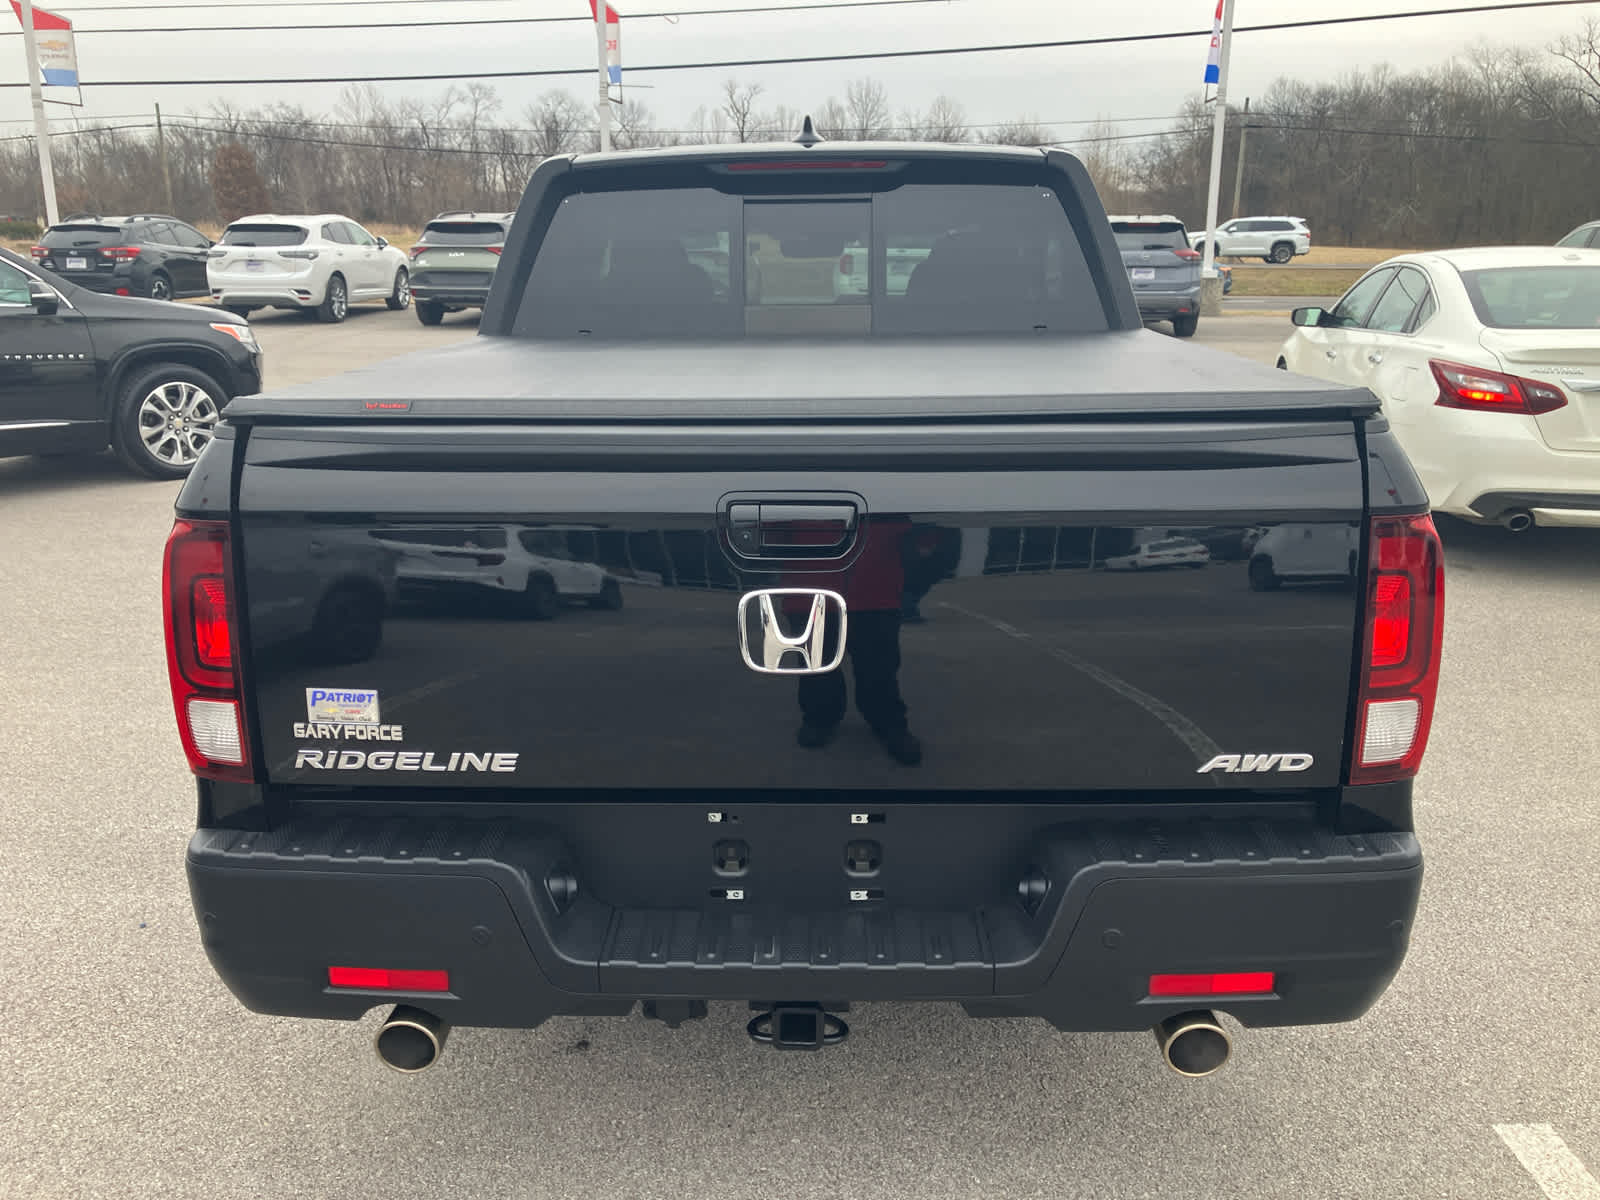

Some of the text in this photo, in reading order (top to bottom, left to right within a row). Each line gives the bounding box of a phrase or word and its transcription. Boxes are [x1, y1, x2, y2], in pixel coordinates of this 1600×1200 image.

[311, 689, 375, 707] PATRIOT
[293, 722, 404, 742] GARY FORCE
[294, 749, 520, 773] RIDGELINE
[1196, 752, 1314, 774] AWD
